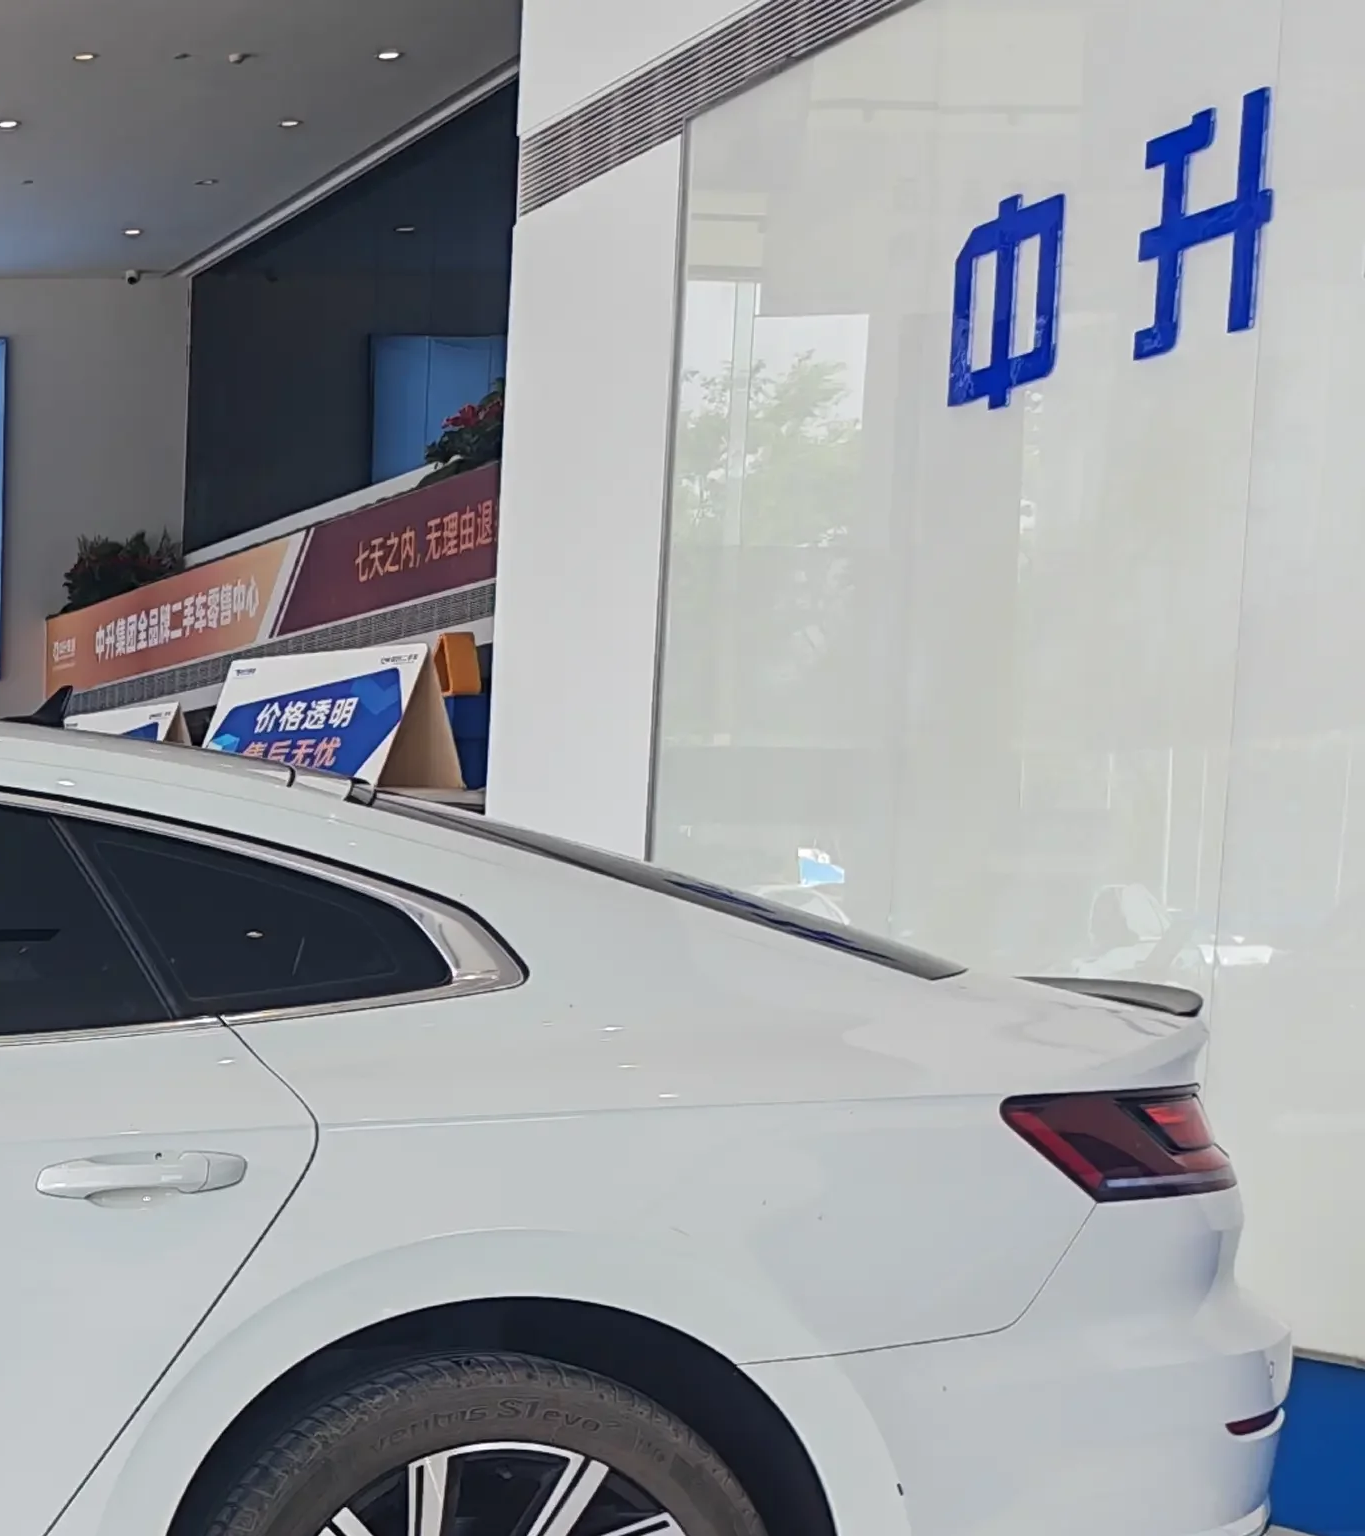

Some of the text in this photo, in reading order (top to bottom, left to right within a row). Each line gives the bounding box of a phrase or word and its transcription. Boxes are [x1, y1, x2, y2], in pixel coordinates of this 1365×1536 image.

[948, 86, 1274, 411] 中升
[355, 500, 498, 583] 七天之内，无理由退
[95, 575, 260, 664] 中升集团全品牌二手车零售中心
[254, 697, 359, 733] 价格透明
